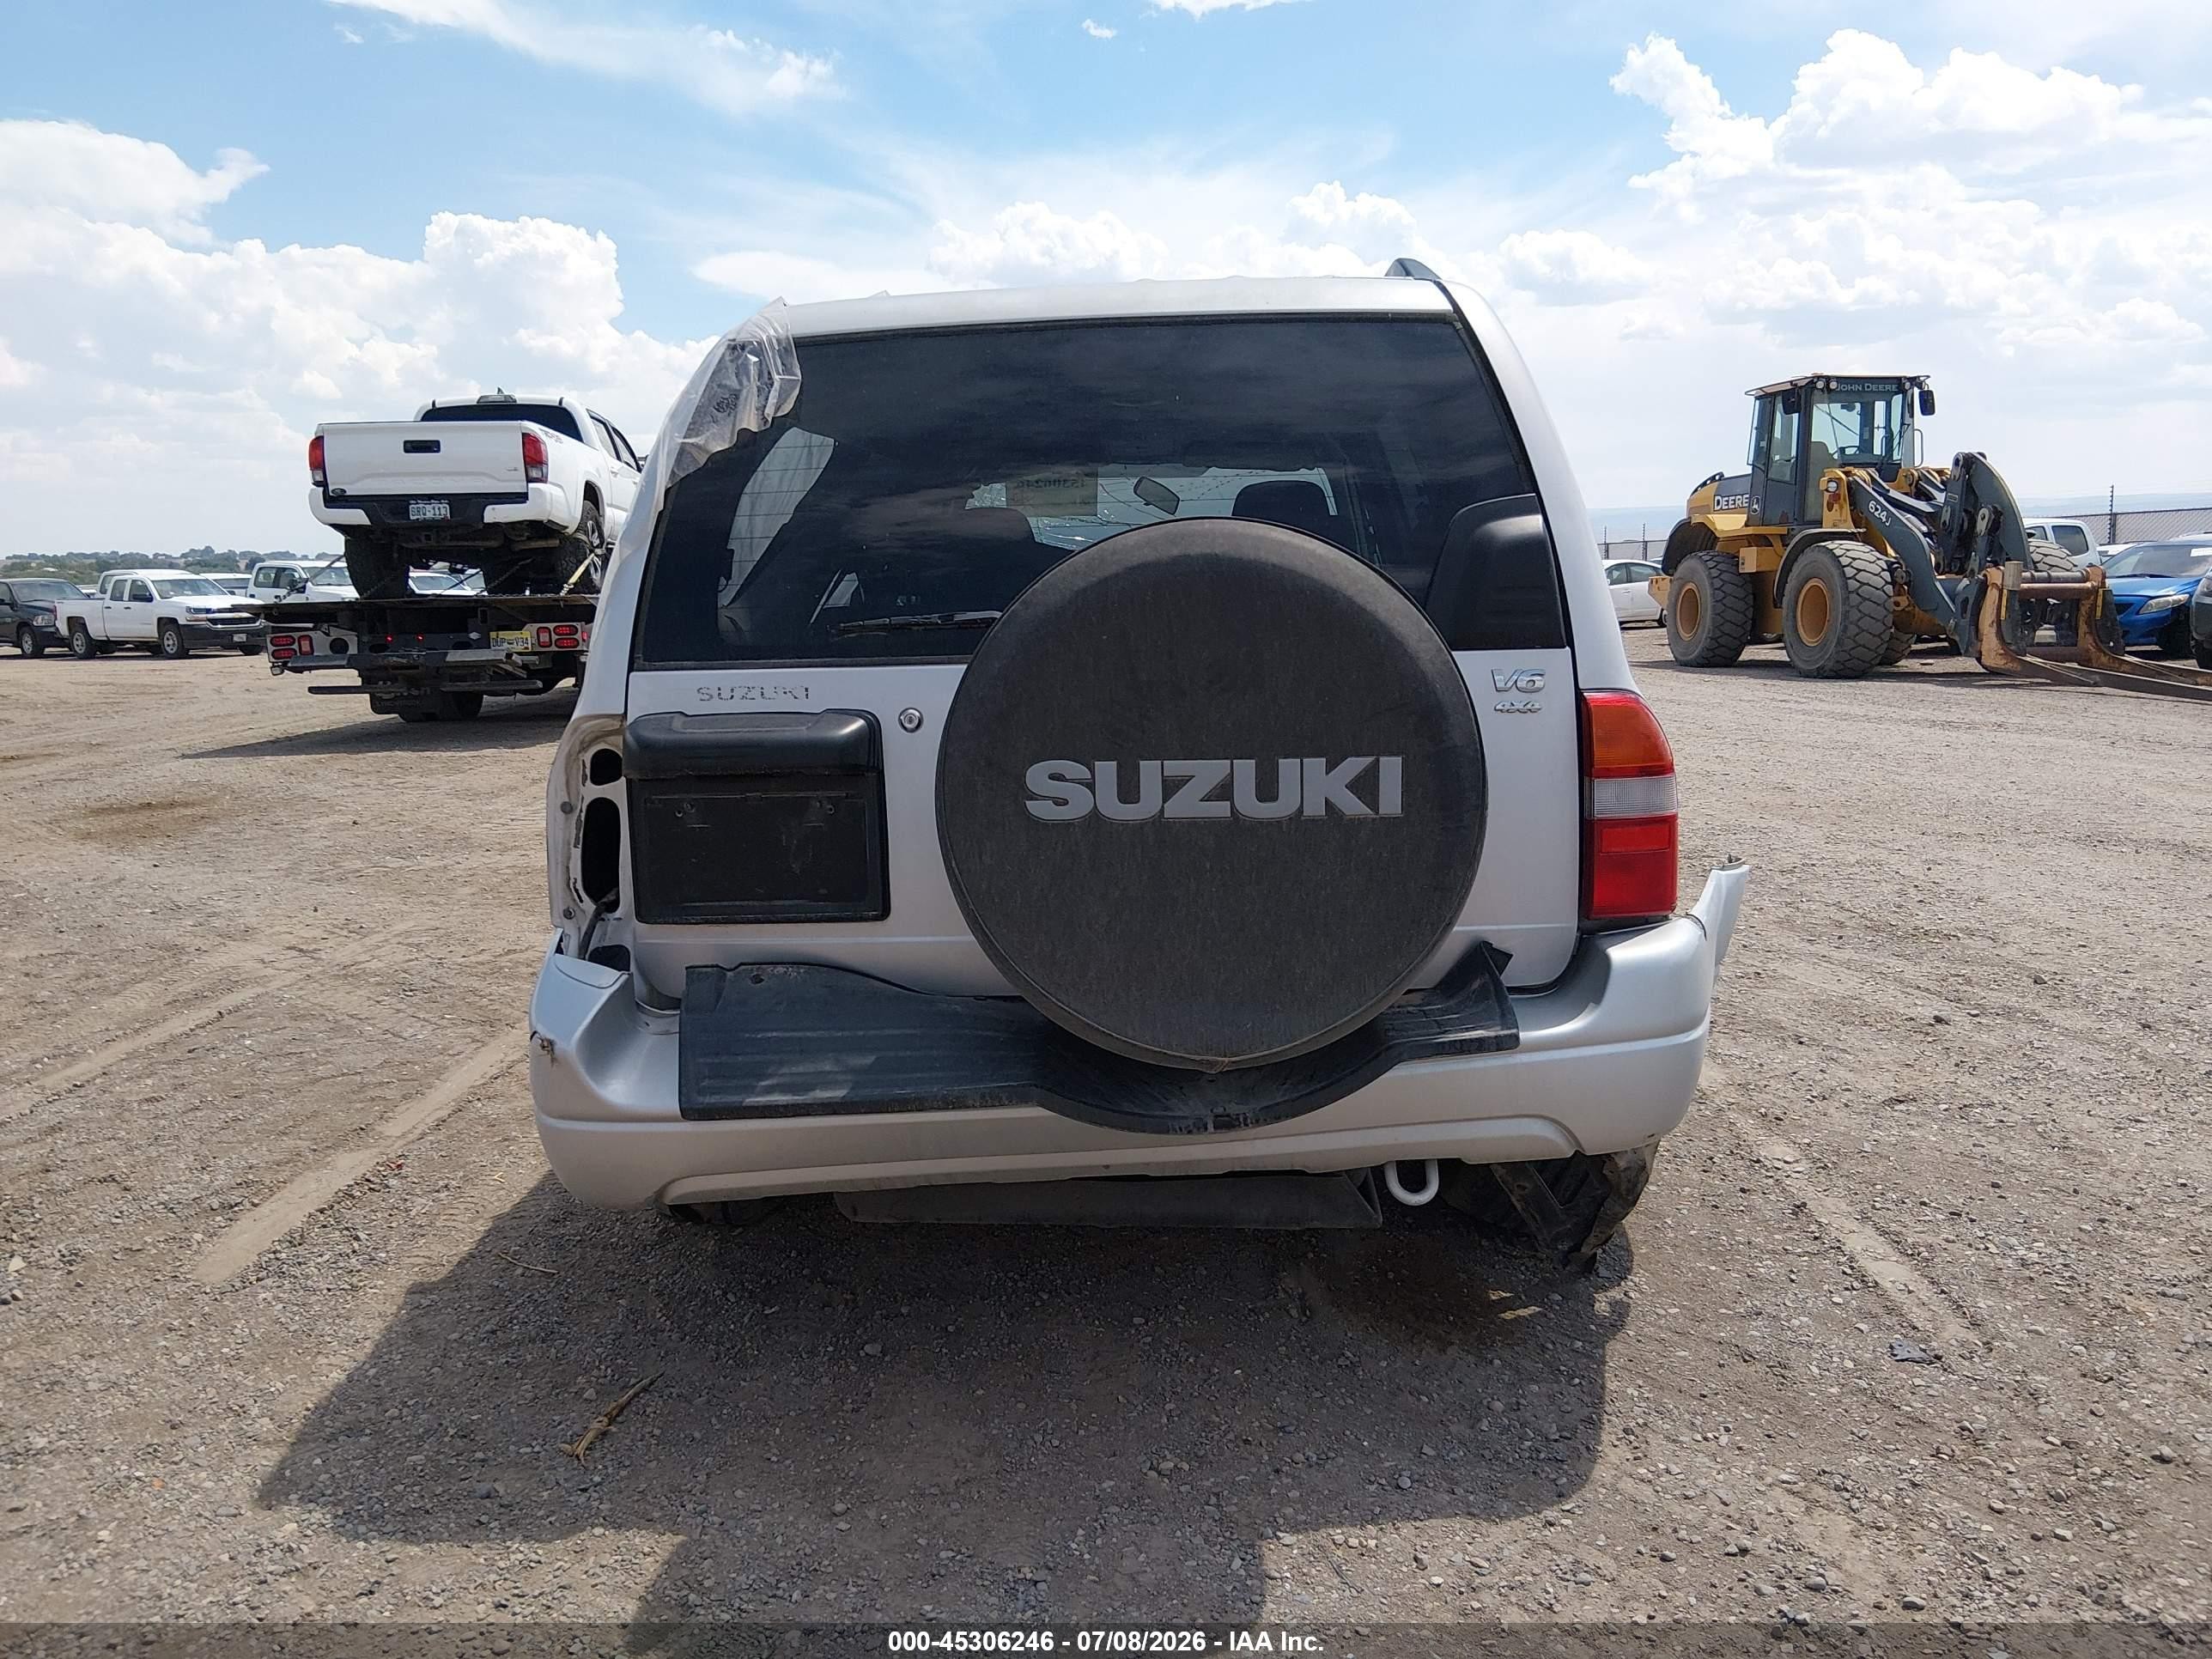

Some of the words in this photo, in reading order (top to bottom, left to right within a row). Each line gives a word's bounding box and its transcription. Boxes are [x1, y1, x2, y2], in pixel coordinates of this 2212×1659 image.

[1864, 383, 1899, 392] DEERE
[1714, 495, 1750, 511] DEERE
[1869, 501, 1892, 526] 624J
[1491, 668, 1546, 693] V6
[696, 685, 810, 702] SUZUKI
[1024, 756, 1404, 822] SUZUKI
